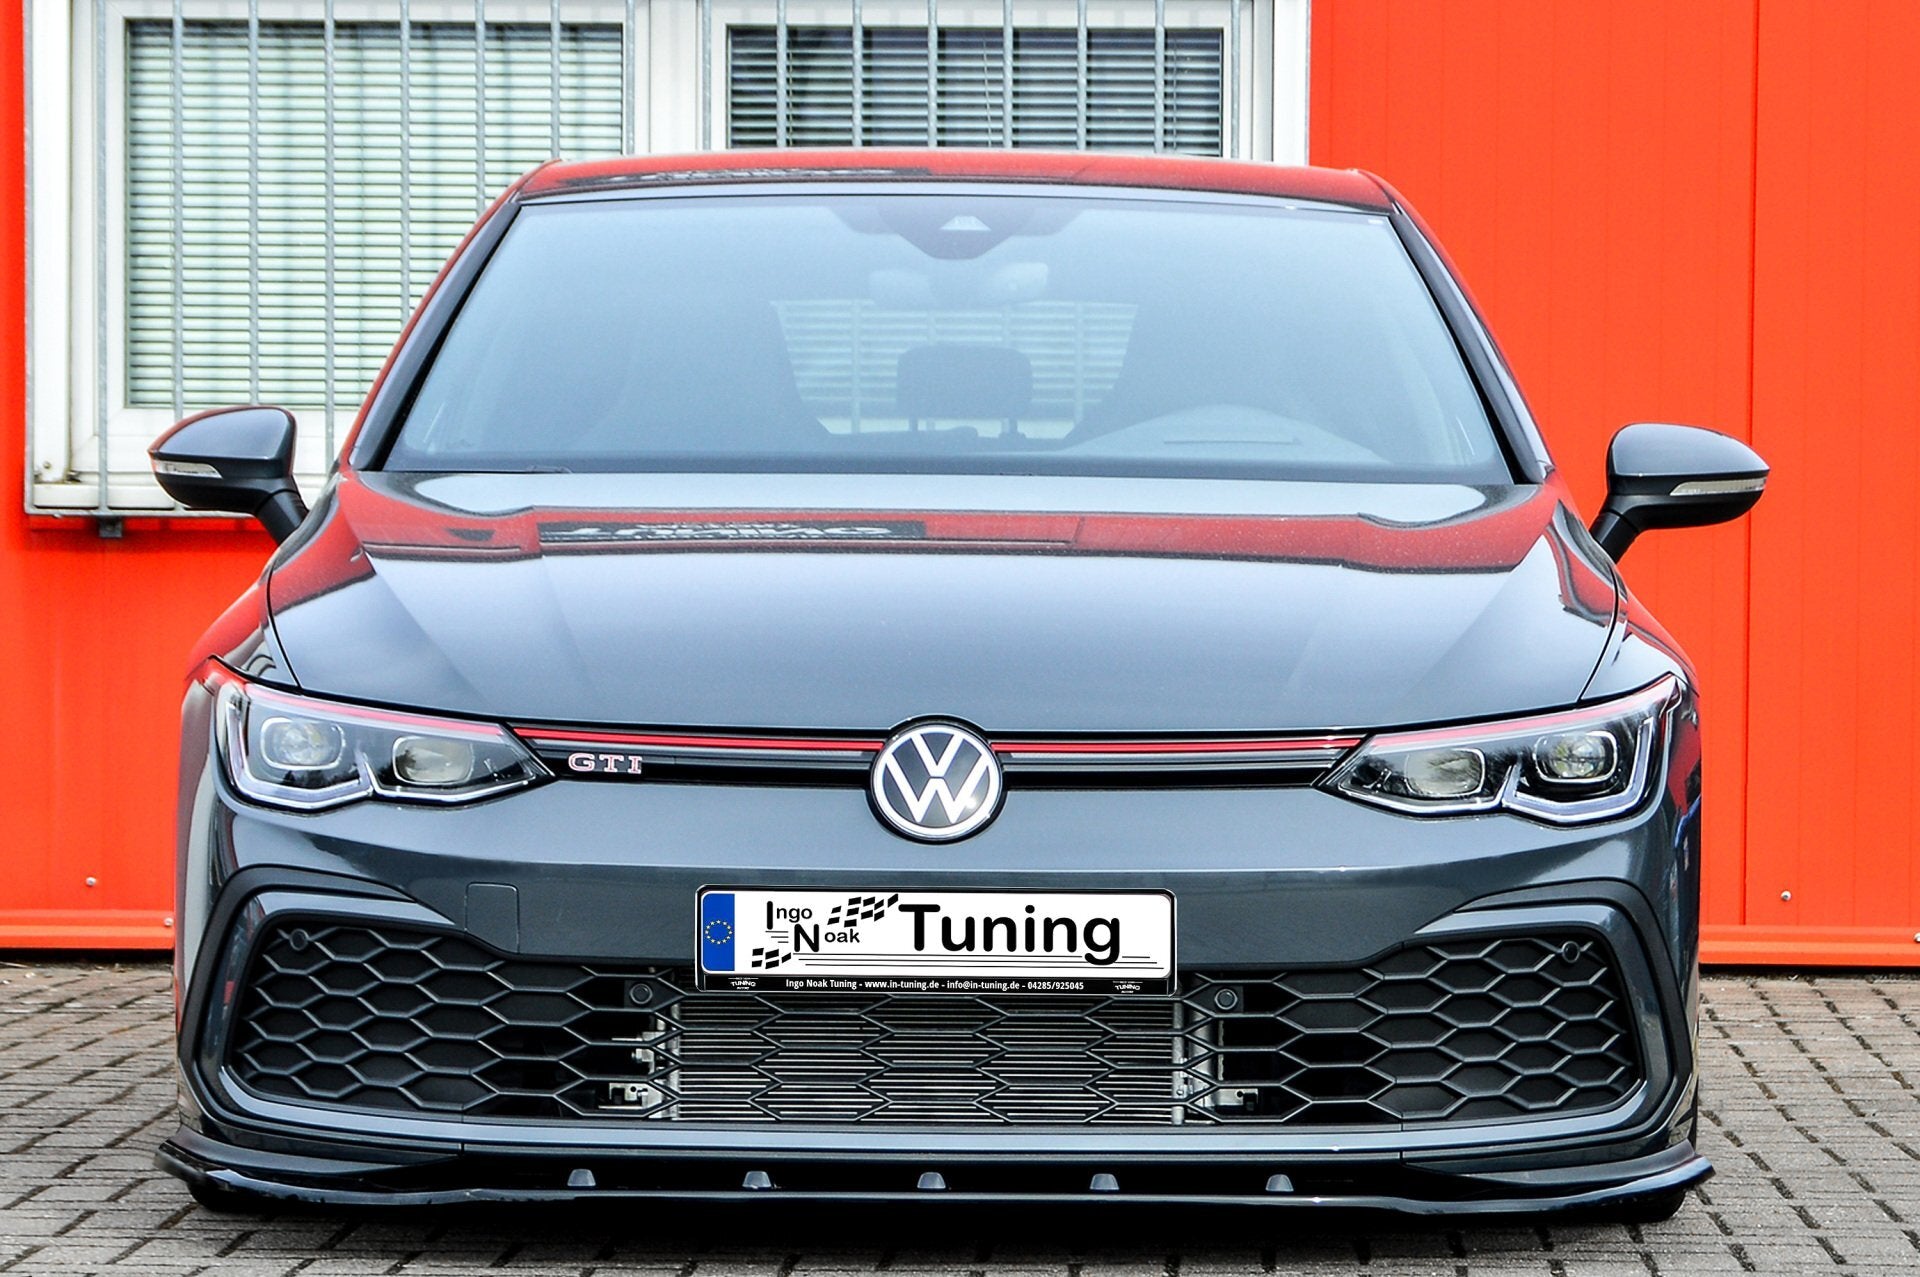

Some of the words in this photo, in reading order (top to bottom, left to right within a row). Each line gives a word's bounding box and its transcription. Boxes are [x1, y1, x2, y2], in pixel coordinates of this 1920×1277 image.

[568, 752, 643, 775] GTI
[766, 900, 813, 930] Ingo
[794, 923, 861, 953] Noak
[898, 903, 1122, 966] Tuning
[785, 979, 804, 990] Ingo
[806, 979, 828, 988] Noak
[830, 979, 857, 990] Tuning
[865, 980, 940, 990] www.in-tuning.de
[946, 980, 1020, 991] info@in-tuning.de
[1027, 981, 1084, 990] 04285/925045
